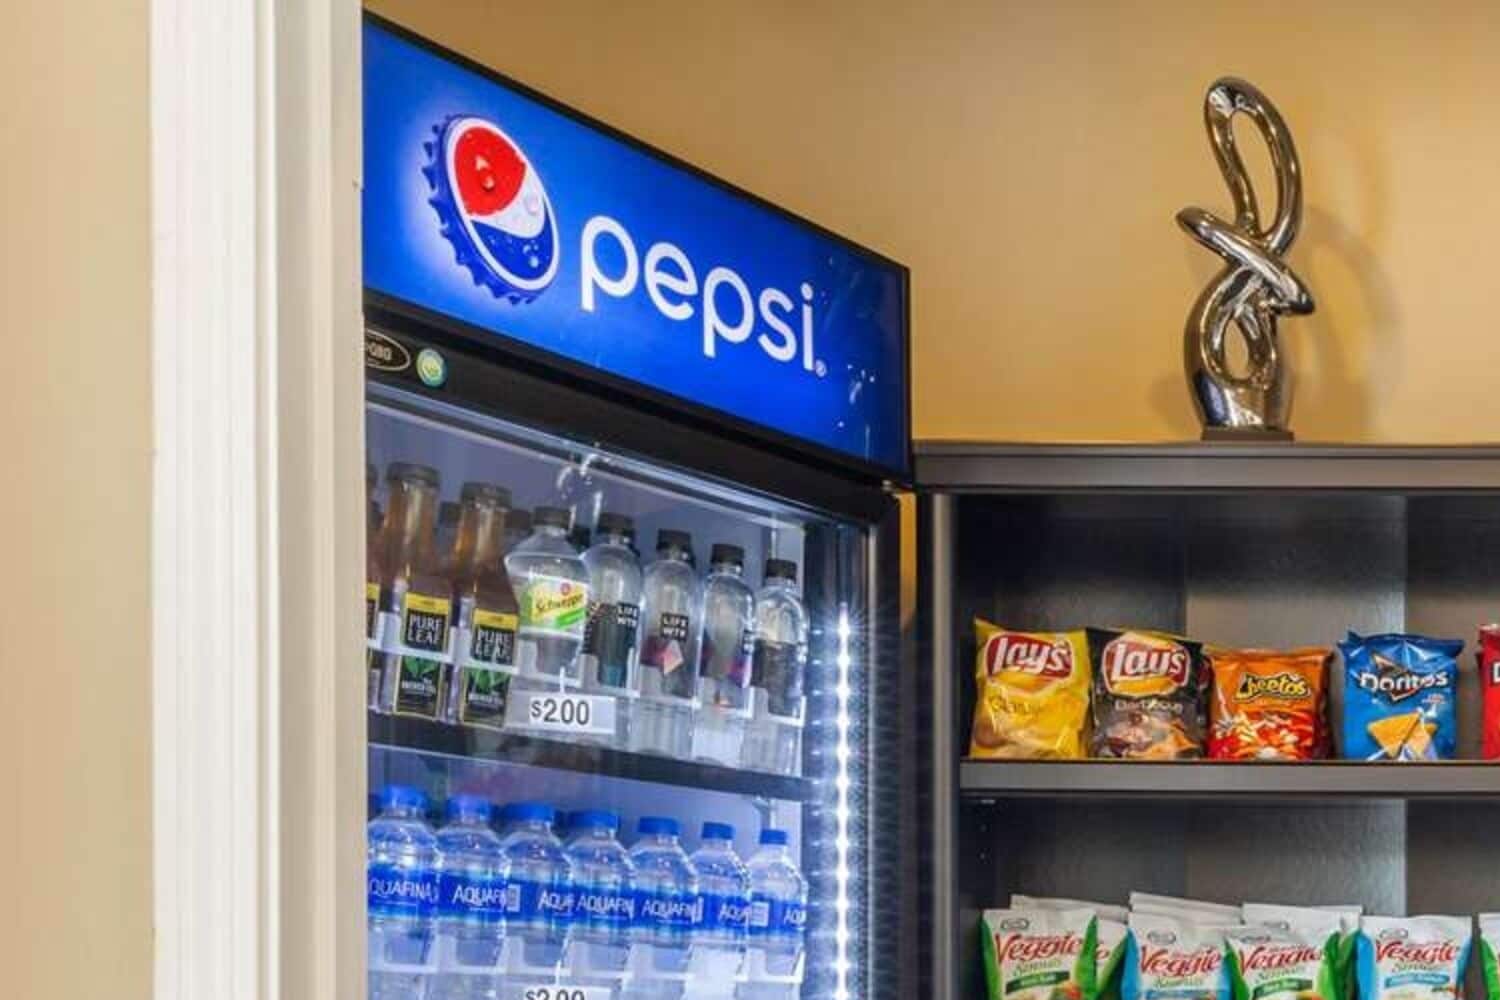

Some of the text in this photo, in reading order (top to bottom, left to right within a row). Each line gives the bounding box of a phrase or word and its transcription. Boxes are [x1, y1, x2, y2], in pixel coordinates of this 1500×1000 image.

[581, 216, 815, 371] pepsi
[1360, 669, 1449, 693] Doritos
[1141, 944, 1222, 977] Veggie
